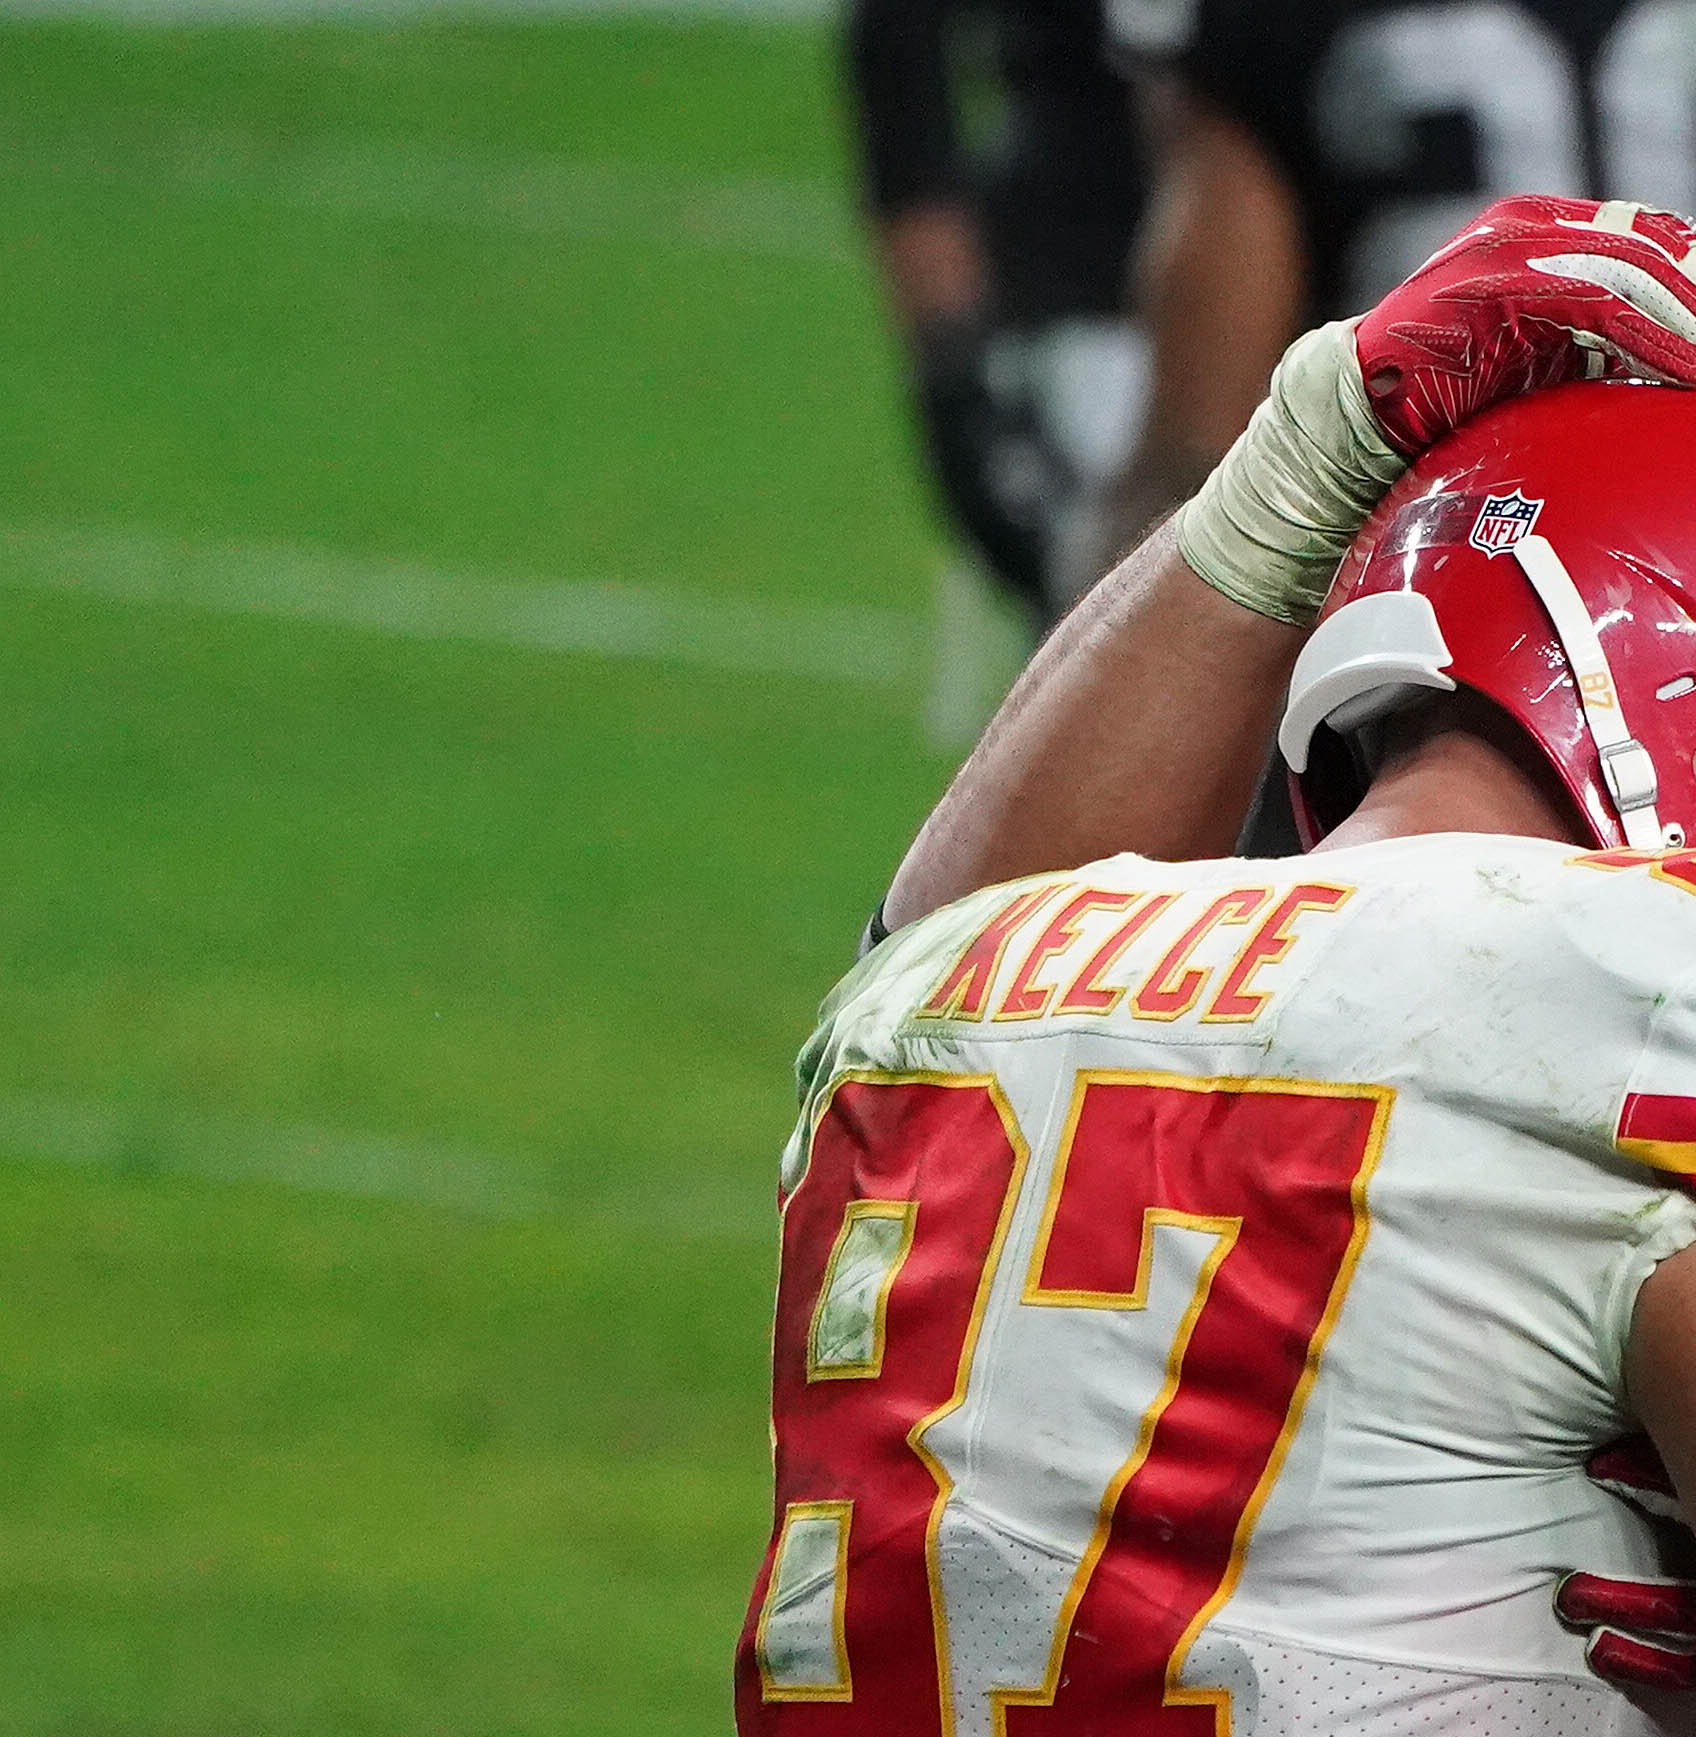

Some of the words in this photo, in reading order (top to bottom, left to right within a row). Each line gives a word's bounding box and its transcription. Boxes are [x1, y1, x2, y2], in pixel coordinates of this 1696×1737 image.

[1477, 518, 1522, 546] NFL
[1580, 672, 1613, 709] 87
[914, 881, 1356, 1024] KELCE
